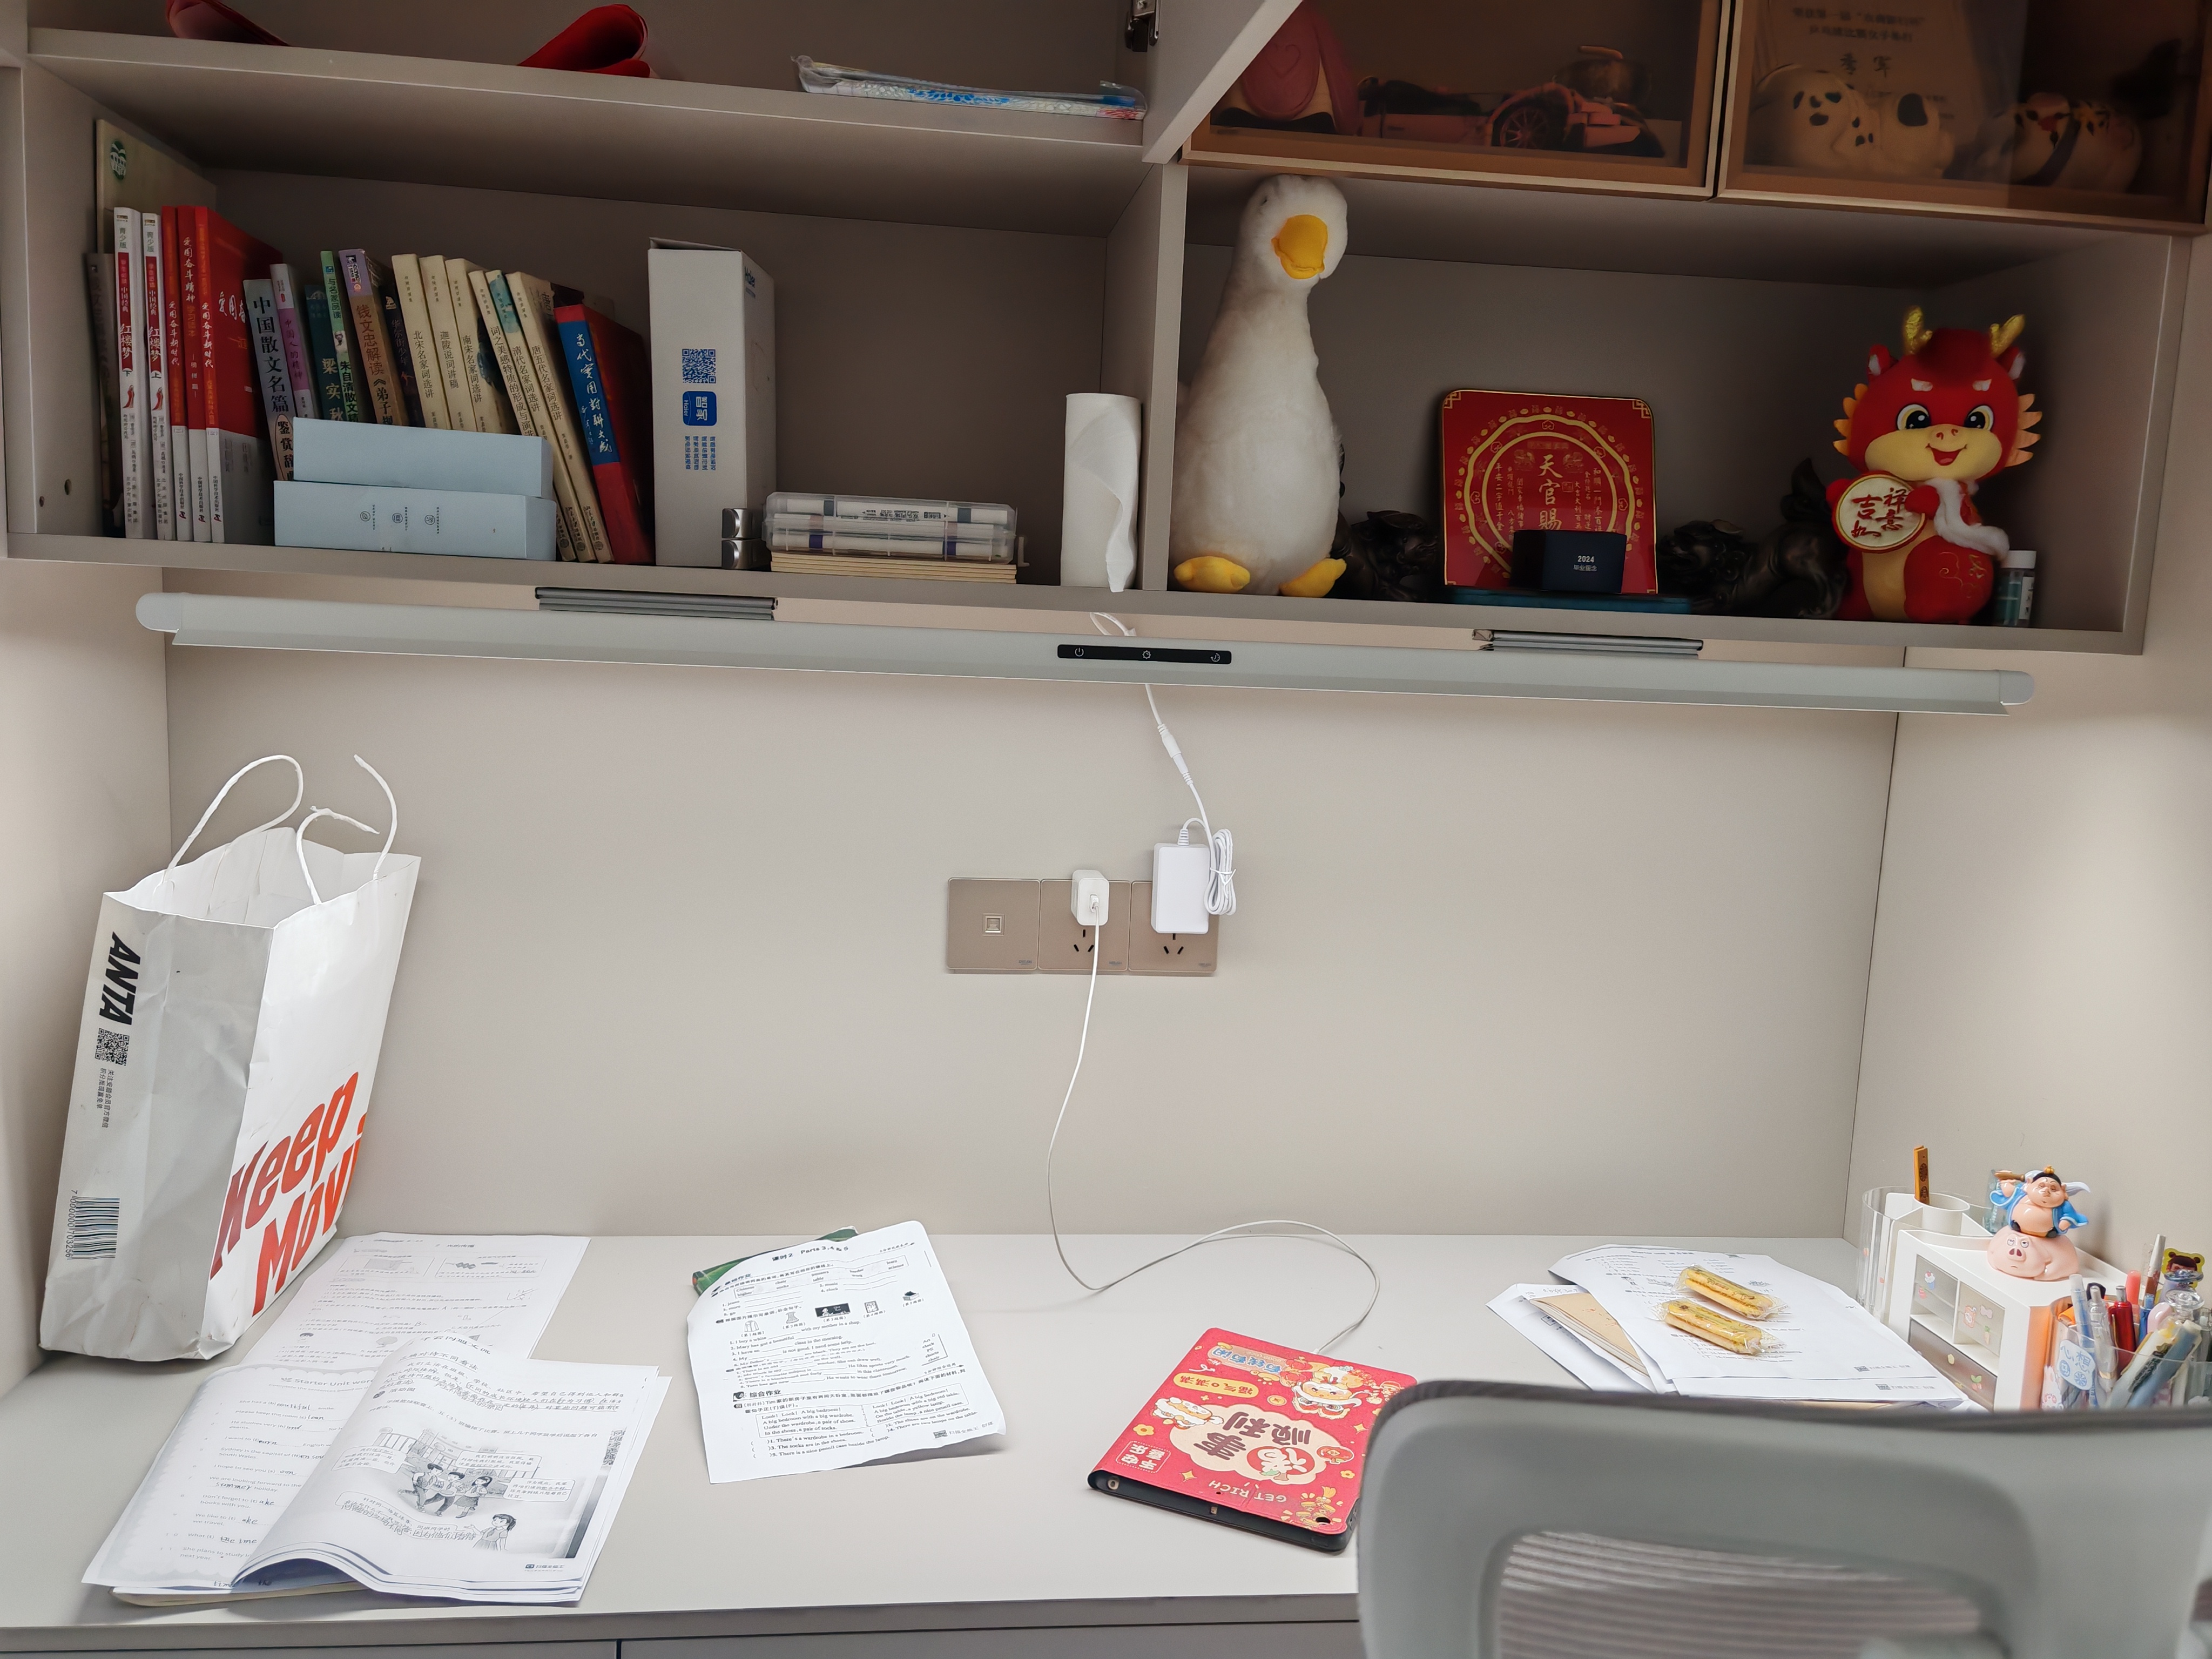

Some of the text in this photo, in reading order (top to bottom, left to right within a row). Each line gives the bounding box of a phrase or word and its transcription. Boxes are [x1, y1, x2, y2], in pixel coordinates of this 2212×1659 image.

[183, 236, 195, 305] 爱国奋斗精神
[327, 278, 342, 319] 与名家品读
[119, 323, 133, 360] 红楼梦
[148, 326, 161, 362] 红楼梦
[168, 301, 179, 366] 爱国奋斗新时代
[201, 302, 213, 368] 爱国奋斗新时代
[253, 296, 289, 413] 中国散文名篇
[413, 330, 435, 399] 北宋名家词选讲
[440, 331, 460, 389] 迦陵说词讲稿
[462, 335, 483, 403] 南宋名家词选讲
[321, 358, 344, 422] 梁实秋
[512, 346, 541, 413] 清代名家词选讲
[531, 345, 563, 421] 唐五代名家词选讲
[695, 395, 708, 422] 智家
[1494, 462, 1505, 531] 平安二字值千金
[99, 931, 141, 1026] ANTA
[102, 1068, 115, 1129] 关注安踏会员官方微信
[210, 1071, 359, 1281] Keep
[68, 1199, 76, 1227] 000000
[65, 1230, 75, 1258] 703256
[1212, 1347, 1282, 1374] 有钱有闲
[2060, 1345, 2092, 1374] 心想
[294, 1378, 327, 1387] Starter
[749, 1389, 782, 1398] 综合作业
[818, 1445, 835, 1453] pencil
[1222, 1410, 1312, 1447] 顺利
[1121, 1453, 1158, 1472] 平安
[1131, 1443, 1165, 1461] 喜乐
[1208, 1479, 1287, 1503] GET RICH
